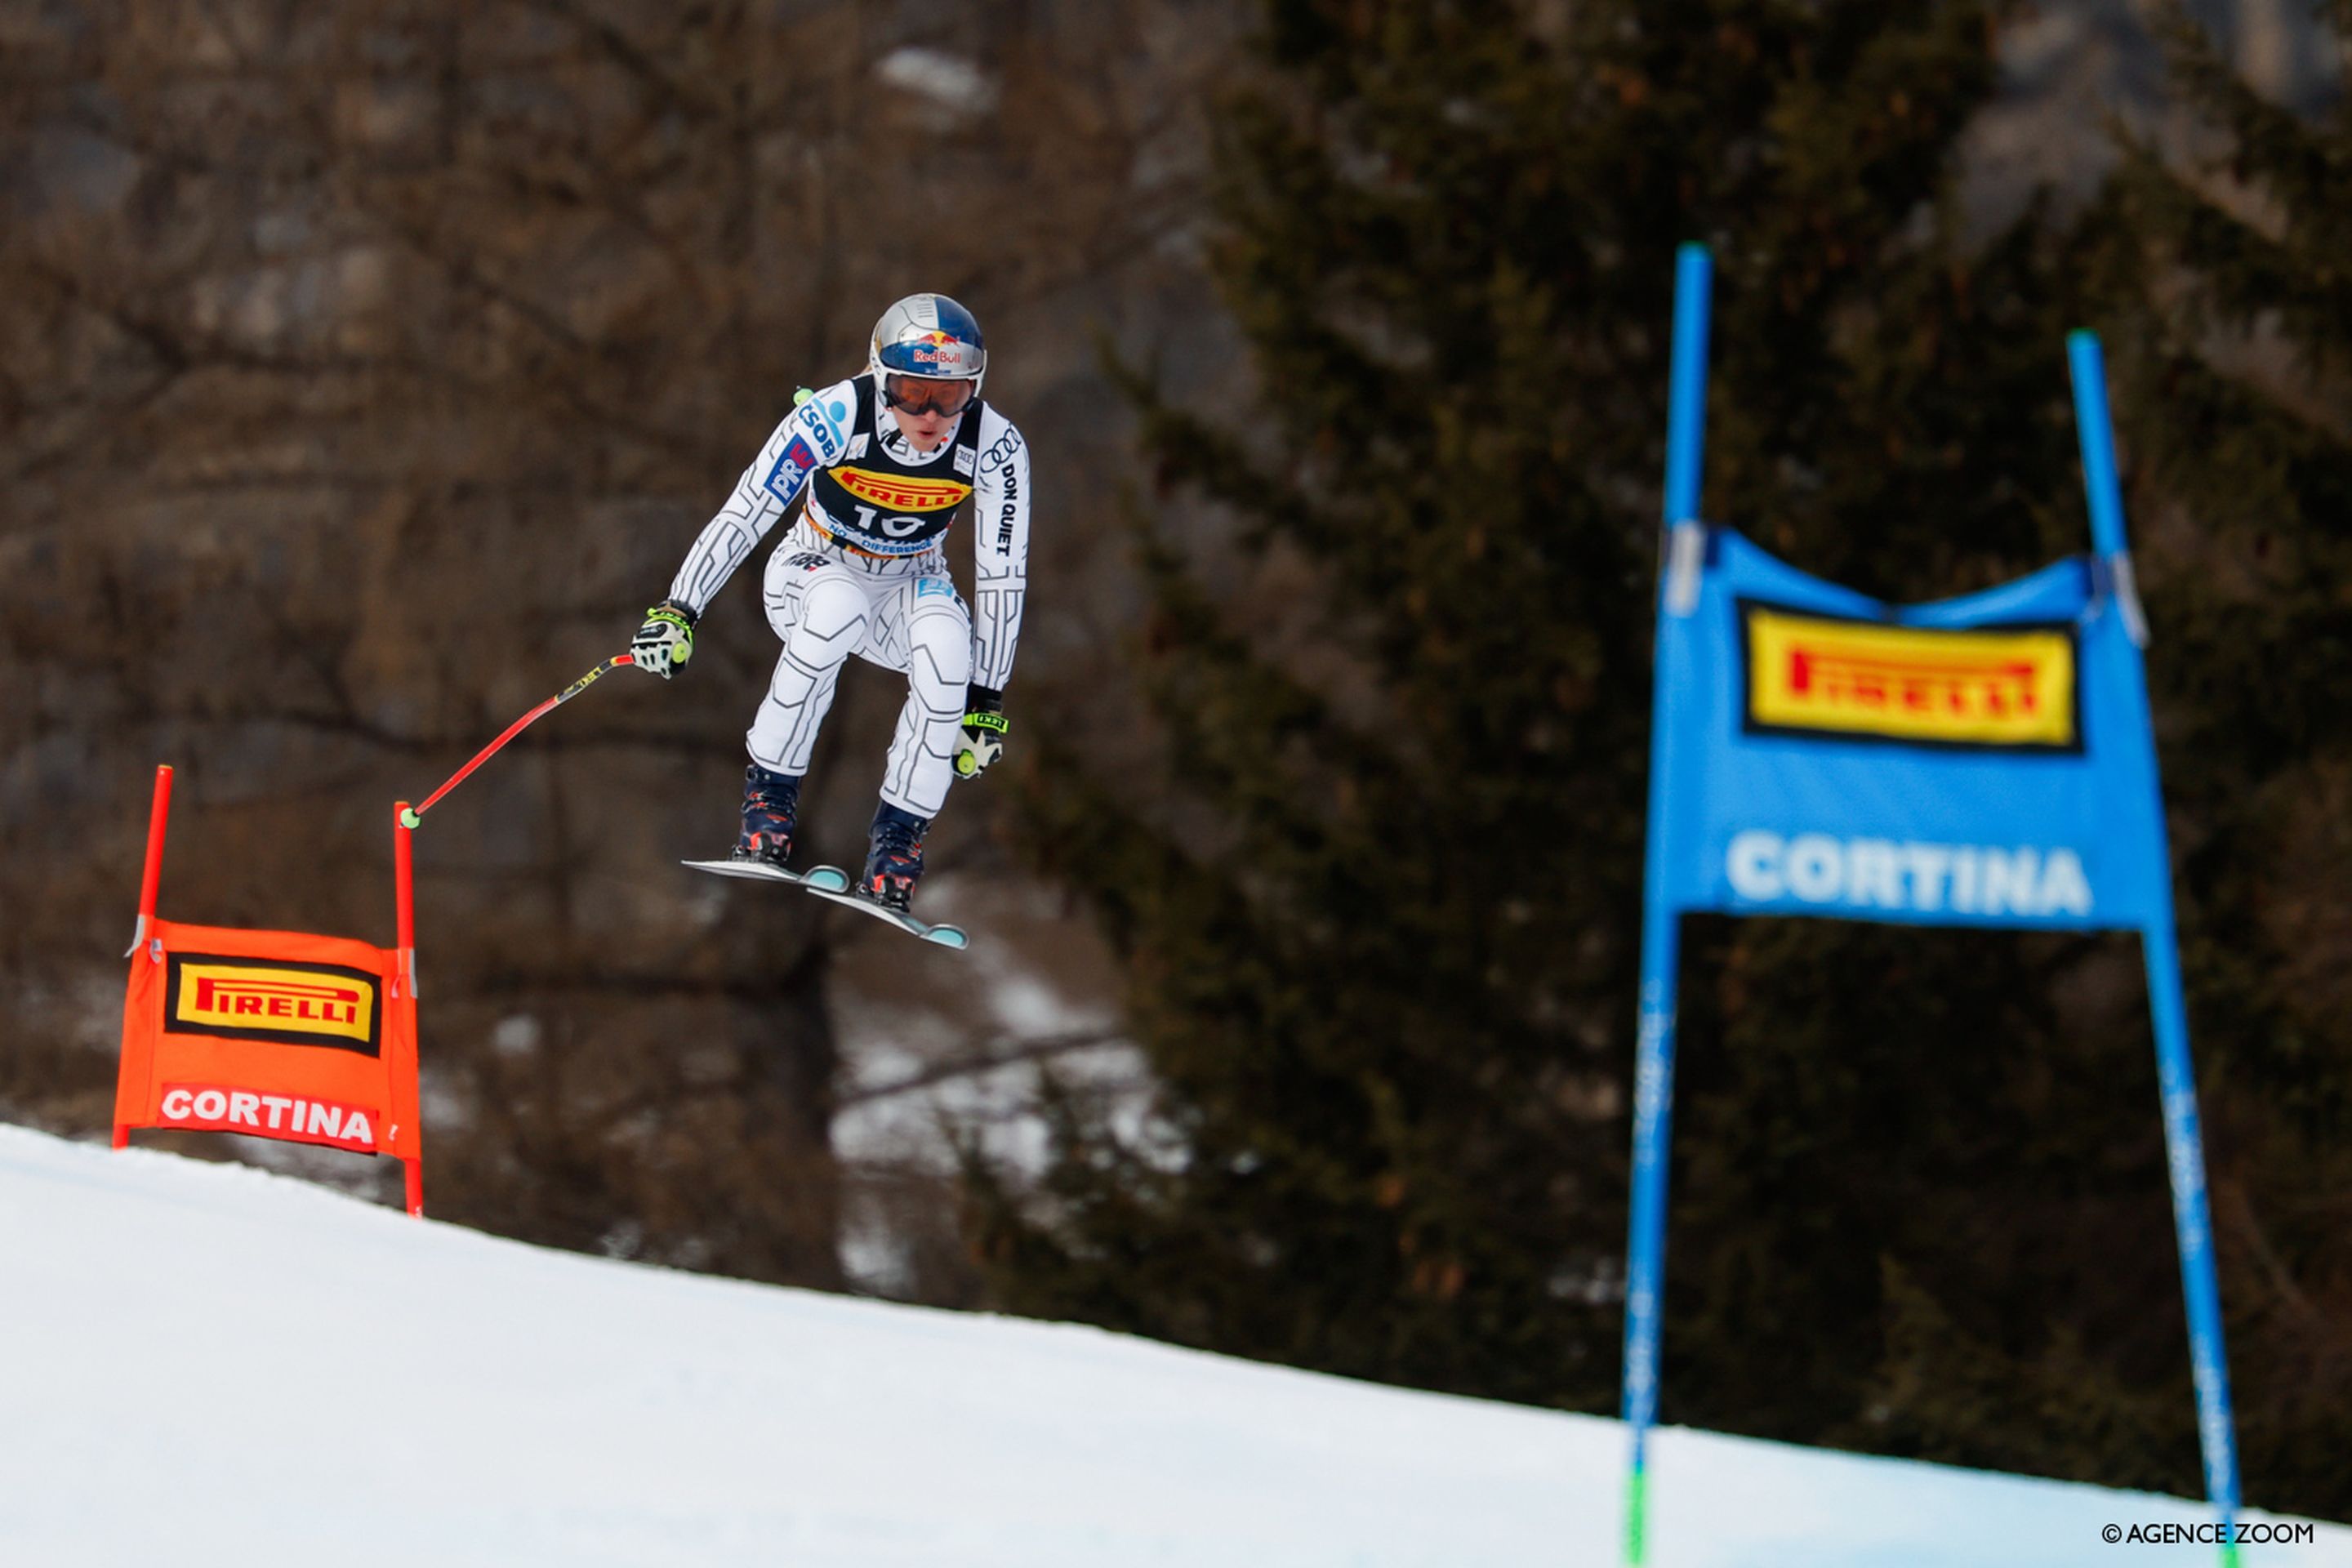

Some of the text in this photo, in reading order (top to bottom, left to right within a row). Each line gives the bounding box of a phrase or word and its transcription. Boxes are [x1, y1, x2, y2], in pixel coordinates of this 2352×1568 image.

[914, 350, 960, 363] Red Bull
[771, 443, 814, 501] PRE
[841, 471, 963, 507] PIRELLI
[996, 464, 1017, 557] DON QUIET
[829, 524, 847, 537] NO
[862, 539, 933, 554] DIFFERENCE
[1788, 649, 2037, 716] PIRELLI
[1726, 830, 2096, 916] CORTINA
[196, 977, 360, 1024] PIRELLI
[162, 1089, 373, 1143] CORTINA
